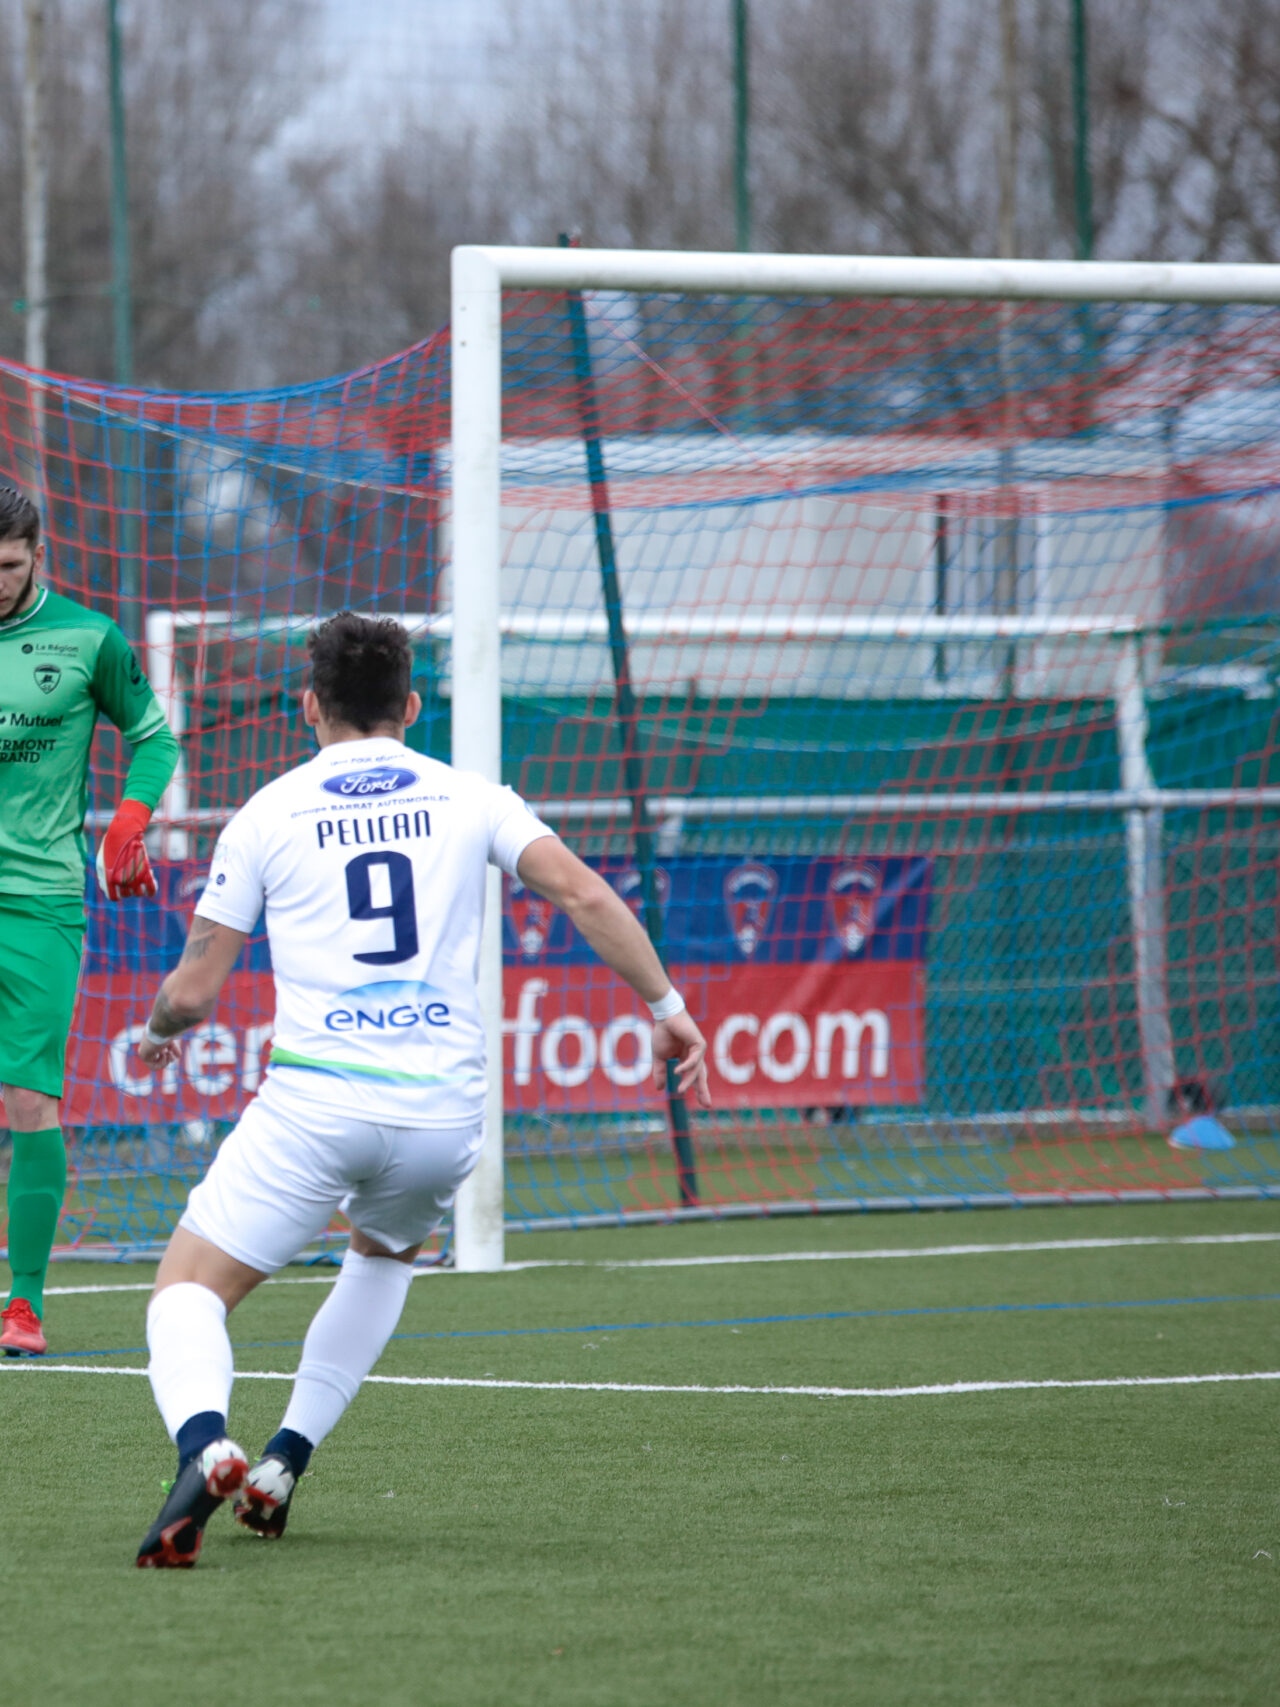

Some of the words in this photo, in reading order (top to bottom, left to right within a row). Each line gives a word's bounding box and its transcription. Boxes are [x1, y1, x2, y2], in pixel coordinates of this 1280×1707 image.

[10, 712, 64, 727] Mutuel
[340, 772, 400, 794] Ford
[316, 809, 431, 849] PELICAN
[345, 850, 419, 966] 9
